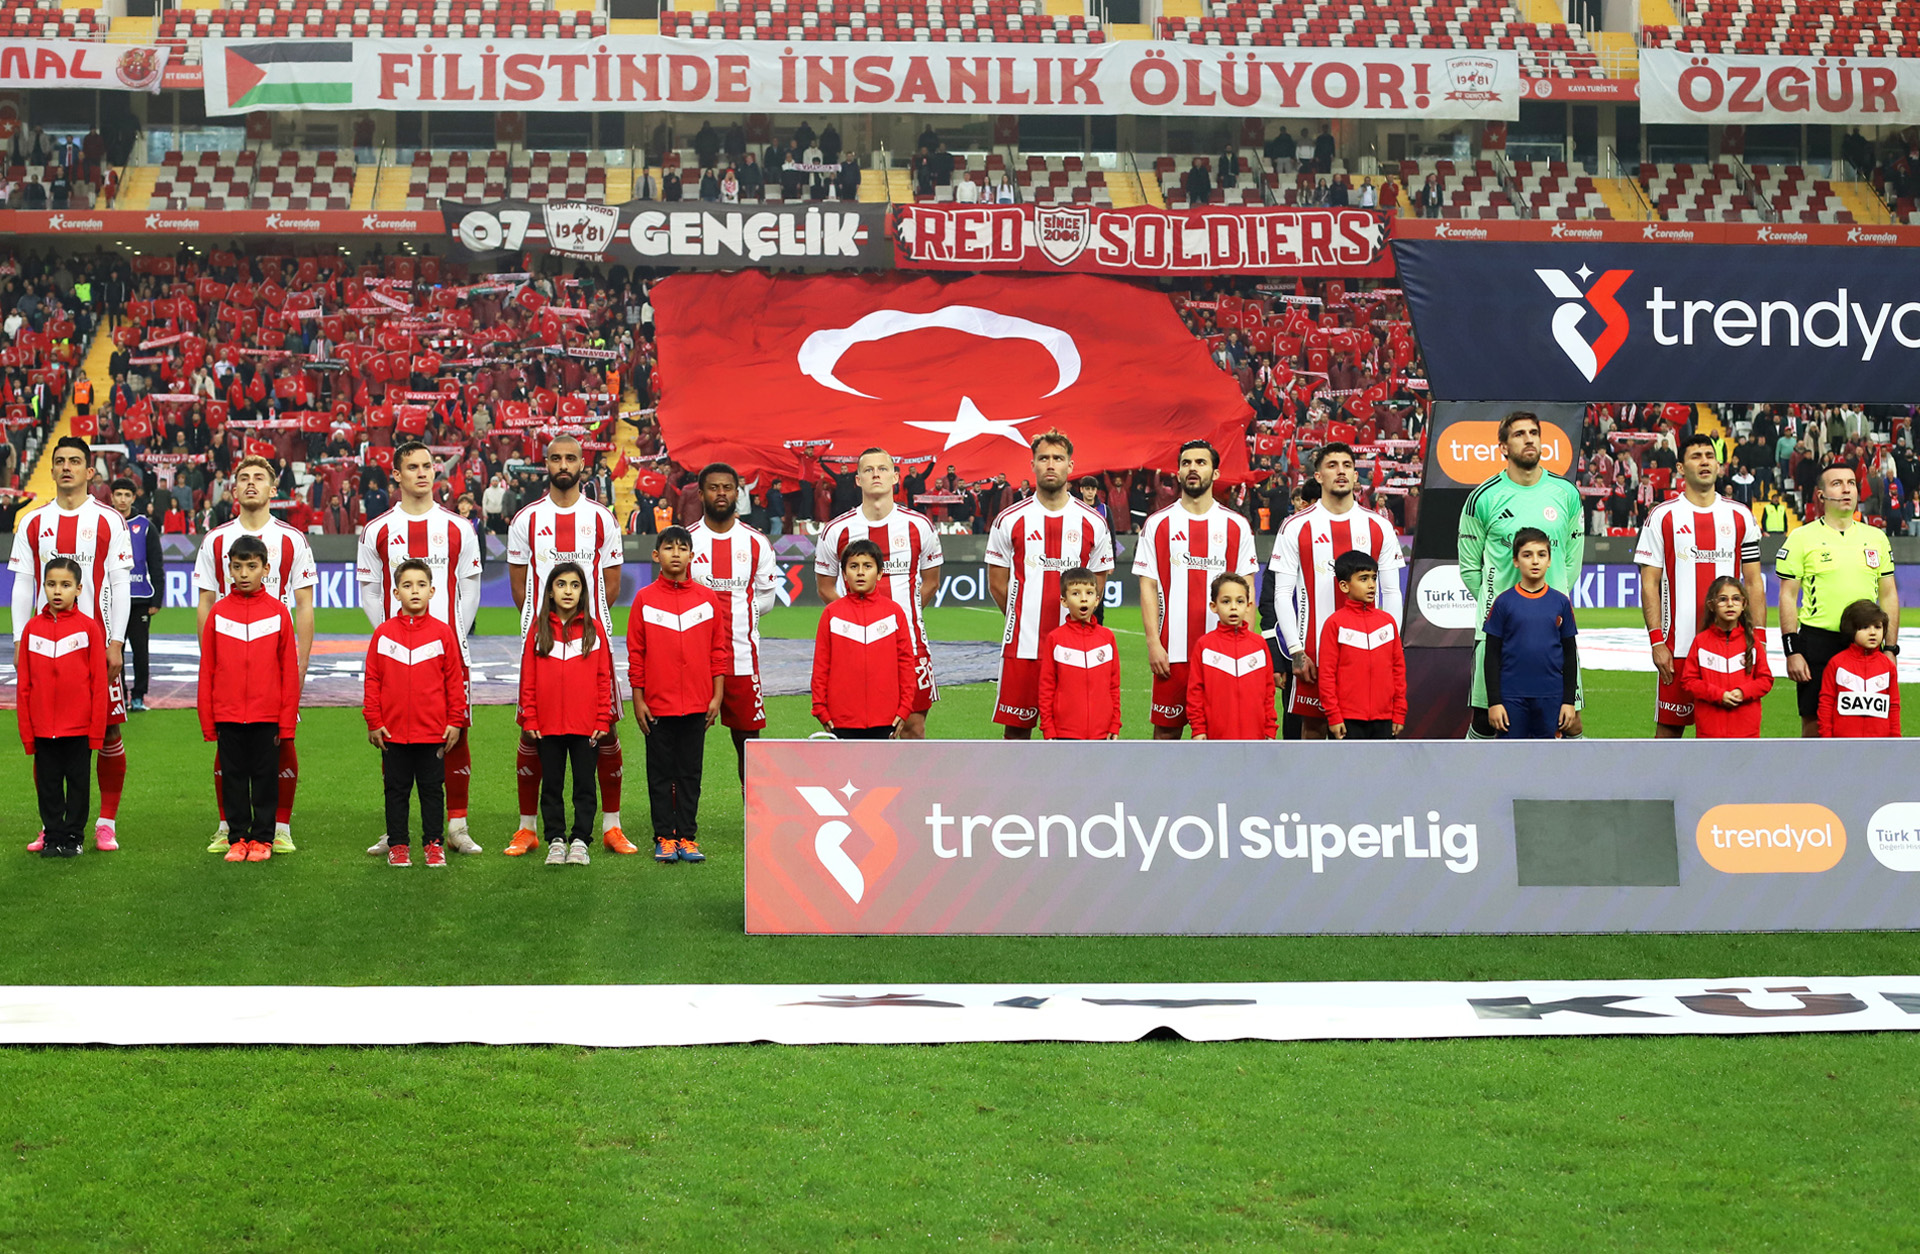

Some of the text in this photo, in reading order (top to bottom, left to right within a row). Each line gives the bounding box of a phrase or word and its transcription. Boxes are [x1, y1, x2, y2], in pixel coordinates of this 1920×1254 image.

[377, 44, 1431, 109] FİLİSTİNDE İNSANLIK ÖLÜYOR!
[1588, 83, 1618, 93] TURİSTİK
[1678, 57, 1900, 113] ÖZGÜR
[62, 219, 103, 228] corendon
[158, 219, 199, 228] corendon
[279, 218, 320, 227] corendon
[375, 219, 417, 228] corendon
[459, 210, 531, 252] 07
[629, 207, 861, 262] GENÇLİK
[1044, 229, 1080, 241] 2006
[1448, 227, 1487, 236] corendon
[1564, 228, 1603, 237] corendon
[1655, 230, 1694, 239] corendon
[1769, 231, 1808, 240] corendon
[1859, 233, 1897, 241] corendon
[910, 206, 1373, 270] RED SOLDIERS
[549, 548, 593, 560] Swandor
[1690, 545, 1732, 559] Swandor
[1038, 554, 1081, 567] Swandor
[1182, 551, 1226, 567] Swandor
[706, 574, 747, 586] Swandor
[1424, 589, 1454, 601] Türk
[1005, 581, 1018, 642] Otomobilen
[1427, 602, 1450, 610] Değerli
[1841, 696, 1887, 713] SAYGI
[925, 802, 1479, 874] trendyol süperLig
[1711, 824, 1832, 852] trendyol
[1876, 829, 1909, 841] Türk
